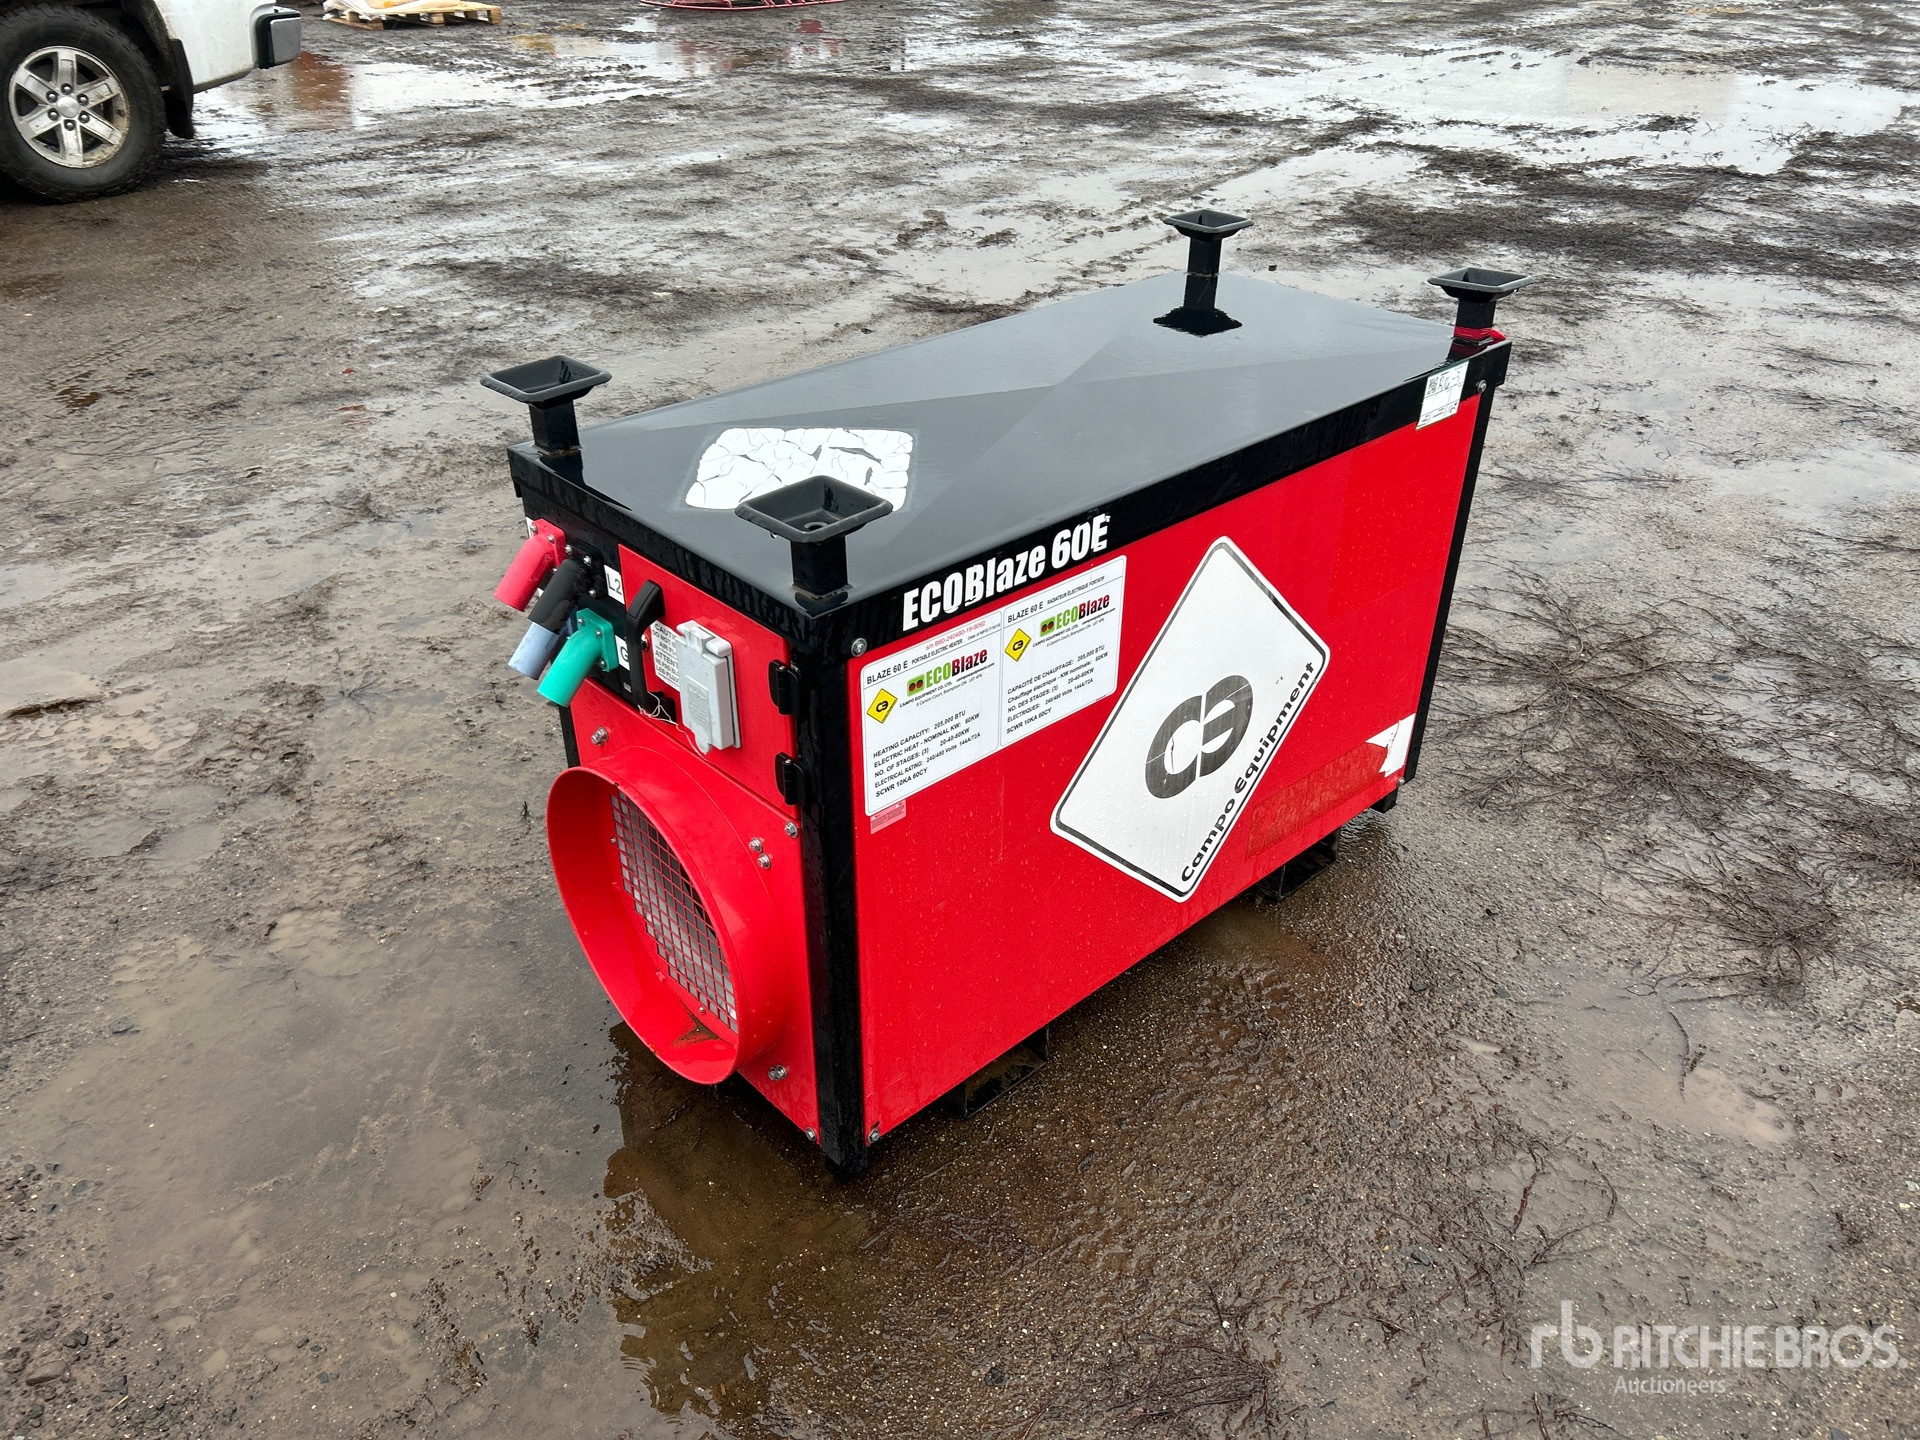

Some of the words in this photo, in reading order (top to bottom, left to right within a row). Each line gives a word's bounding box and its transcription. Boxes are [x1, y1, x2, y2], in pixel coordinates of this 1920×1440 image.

[607, 573, 622, 595] L2
[903, 545, 1046, 631] ECOBlaze
[1051, 513, 1110, 569] 60E
[1007, 607, 1029, 623] BLAZE
[1030, 604, 1037, 613] 60
[1039, 601, 1044, 609] E
[1047, 592, 1067, 605] RADIATEUR
[1056, 594, 1110, 630] ECOBlaze
[620, 646, 629, 661] G
[911, 651, 932, 665] PORTABLE
[930, 645, 949, 657] ELECTRIC
[949, 638, 963, 650] HEATER
[925, 649, 988, 688] ECOBlaze
[866, 666, 891, 685] BLAZE
[893, 663, 902, 673] 60
[903, 660, 909, 669] E
[1007, 677, 1033, 694] CAPACITÉ
[1041, 659, 1074, 678] CHAUFFAGE:
[1095, 645, 1105, 653] BTU
[1007, 688, 1032, 703] Chauffage
[1033, 677, 1057, 692] électrique
[1060, 670, 1069, 678] KW
[1069, 660, 1092, 675] nominale:
[899, 698, 914, 708] CAMPO
[914, 688, 938, 702] EQUIPMENT
[1007, 705, 1017, 713] NO.
[1018, 699, 1028, 708] DES
[1029, 688, 1051, 703] STAGES:
[1007, 703, 1040, 723] ÉLECTRIQUES:
[1061, 688, 1073, 697] Volts
[873, 742, 899, 758] HEATING
[900, 727, 931, 746] CAPACITY:
[933, 715, 954, 730] 205,000
[954, 710, 966, 720] BTU
[874, 749, 903, 768] ELECTRIC
[904, 742, 920, 754] HEAT
[923, 728, 950, 744] NOMINAL
[950, 722, 961, 731] KW:
[965, 712, 980, 724] 60KW
[1006, 721, 1023, 734] SCWR
[874, 769, 885, 778] NO.
[886, 764, 895, 772] OF
[895, 752, 921, 768] STAGES:
[921, 747, 929, 757] (3)
[940, 727, 970, 746] 20-40-60KW
[875, 770, 904, 788] ELECTRICAL
[904, 761, 923, 773] RATING:
[945, 745, 957, 753] Volts
[875, 784, 895, 797] SCWR
[896, 776, 912, 787] 10KA
[912, 767, 928, 779] 60CY
[1181, 798, 1236, 882] Campo
[1234, 662, 1315, 794] Equipment
